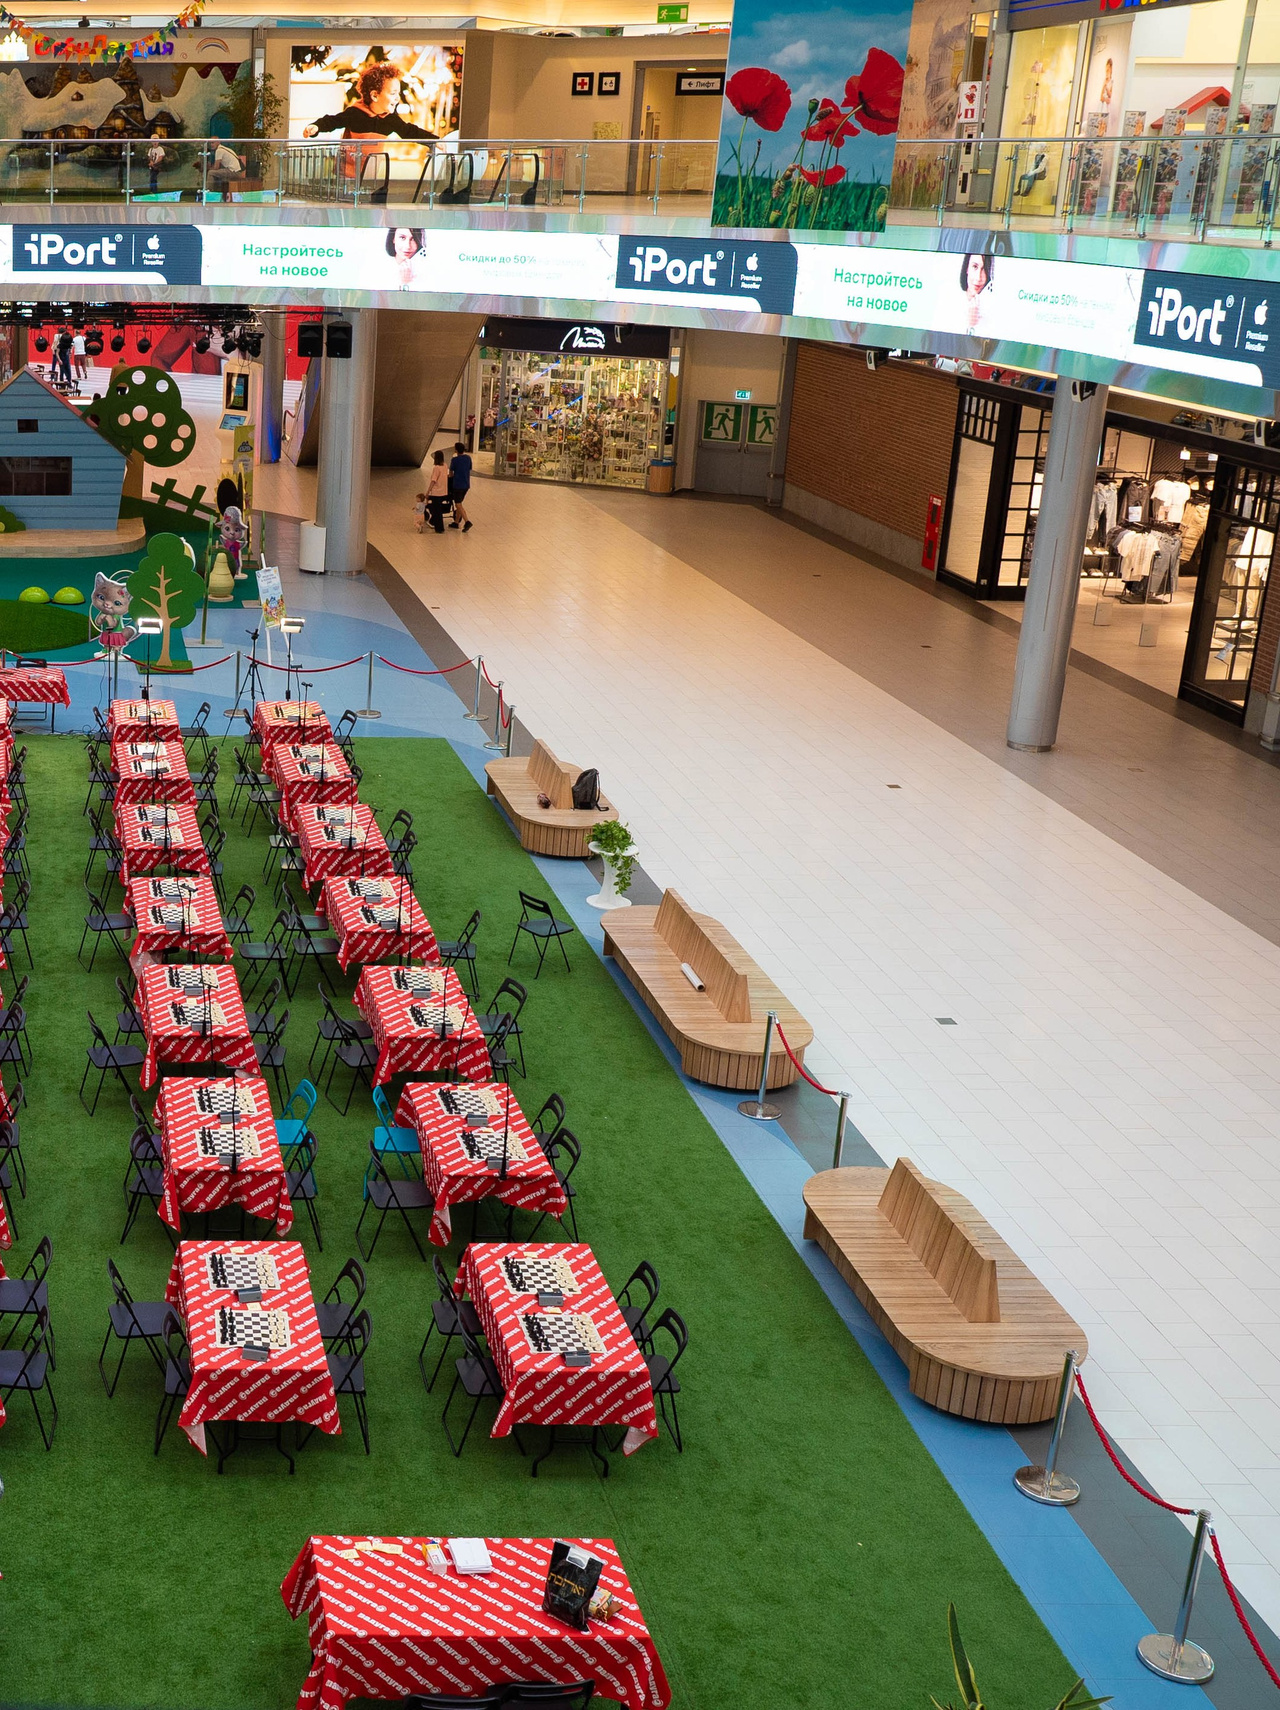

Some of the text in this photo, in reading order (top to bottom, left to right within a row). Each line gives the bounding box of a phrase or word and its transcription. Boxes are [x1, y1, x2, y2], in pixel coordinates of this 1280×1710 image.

[696, 80, 715, 88] Лифт
[243, 243, 344, 259] Настройтесь
[458, 253, 497, 263] Скидки
[498, 255, 511, 264] до
[513, 255, 537, 265] 50%
[260, 265, 328, 277] на новое
[834, 268, 923, 290] Настройтесь
[847, 296, 908, 313] на новое
[1018, 289, 1049, 303] Скидки
[1049, 295, 1060, 305] до
[1061, 294, 1078, 307] 50%
